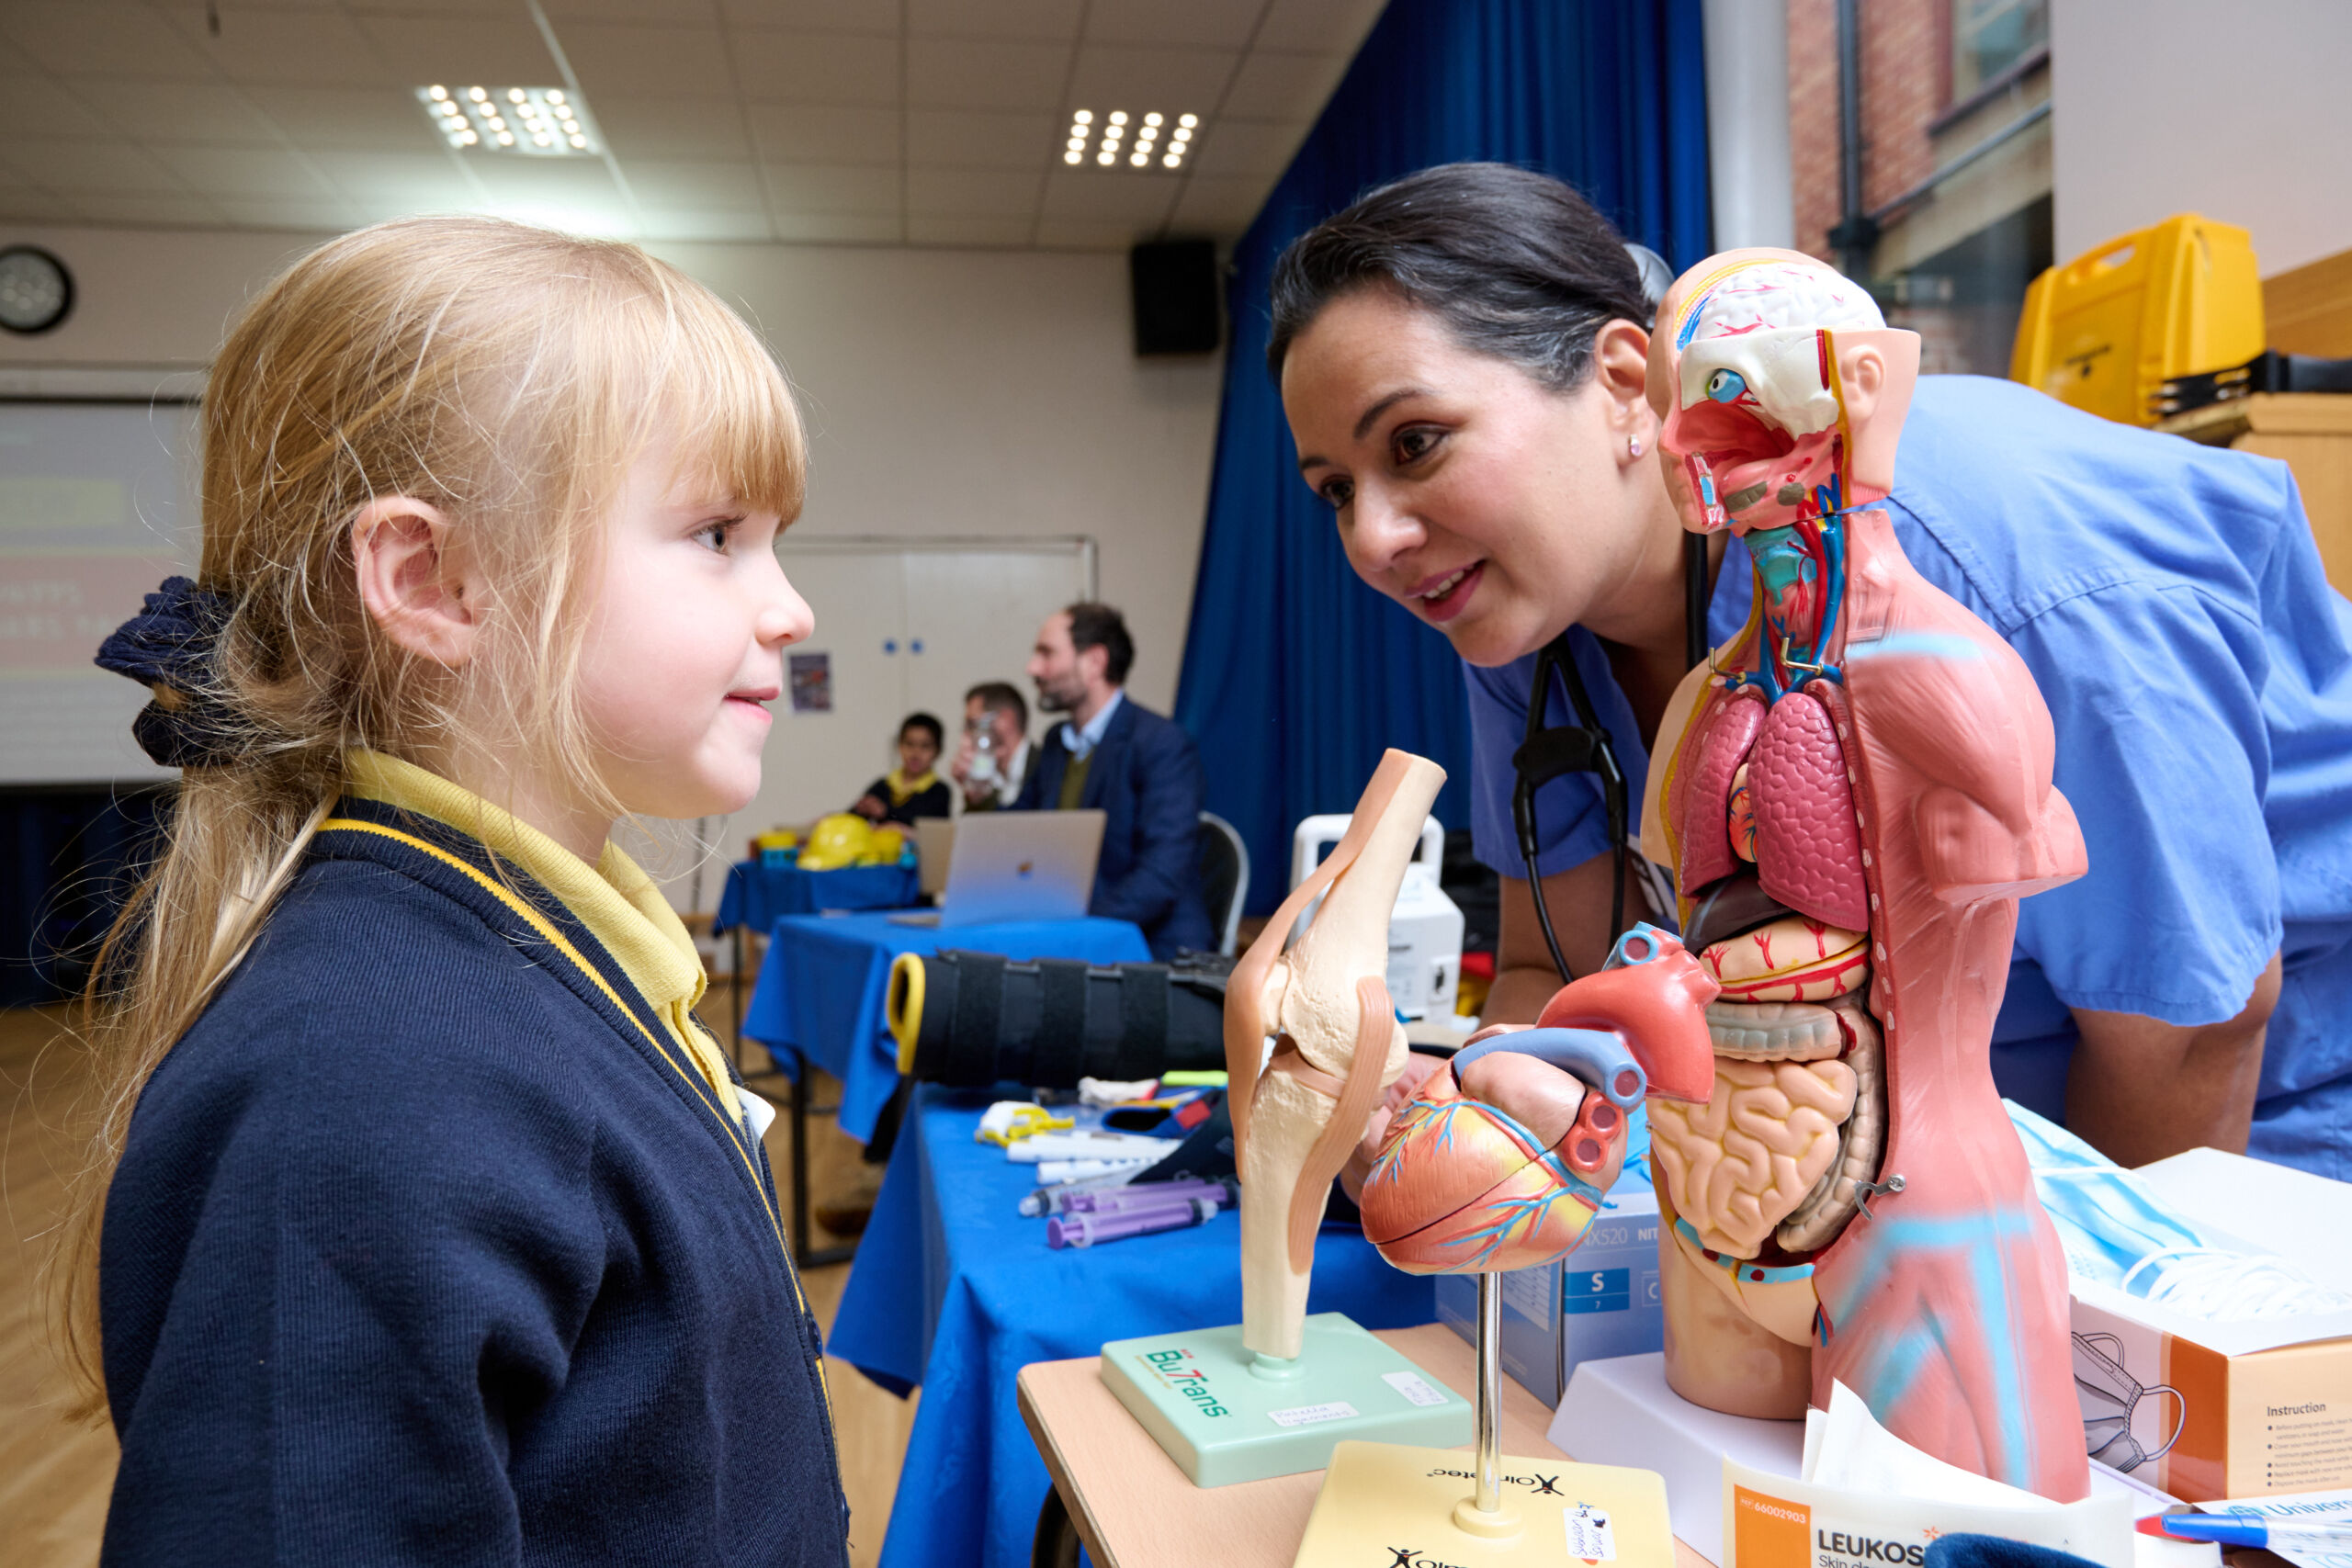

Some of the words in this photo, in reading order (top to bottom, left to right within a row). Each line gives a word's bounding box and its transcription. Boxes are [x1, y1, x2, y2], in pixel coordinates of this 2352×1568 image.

[1591, 1272, 1604, 1292] S
[1146, 1349, 1228, 1417] BuTrans
[2267, 1402, 2326, 1416] Instruction
[1754, 1501, 1807, 1525] 66002903
